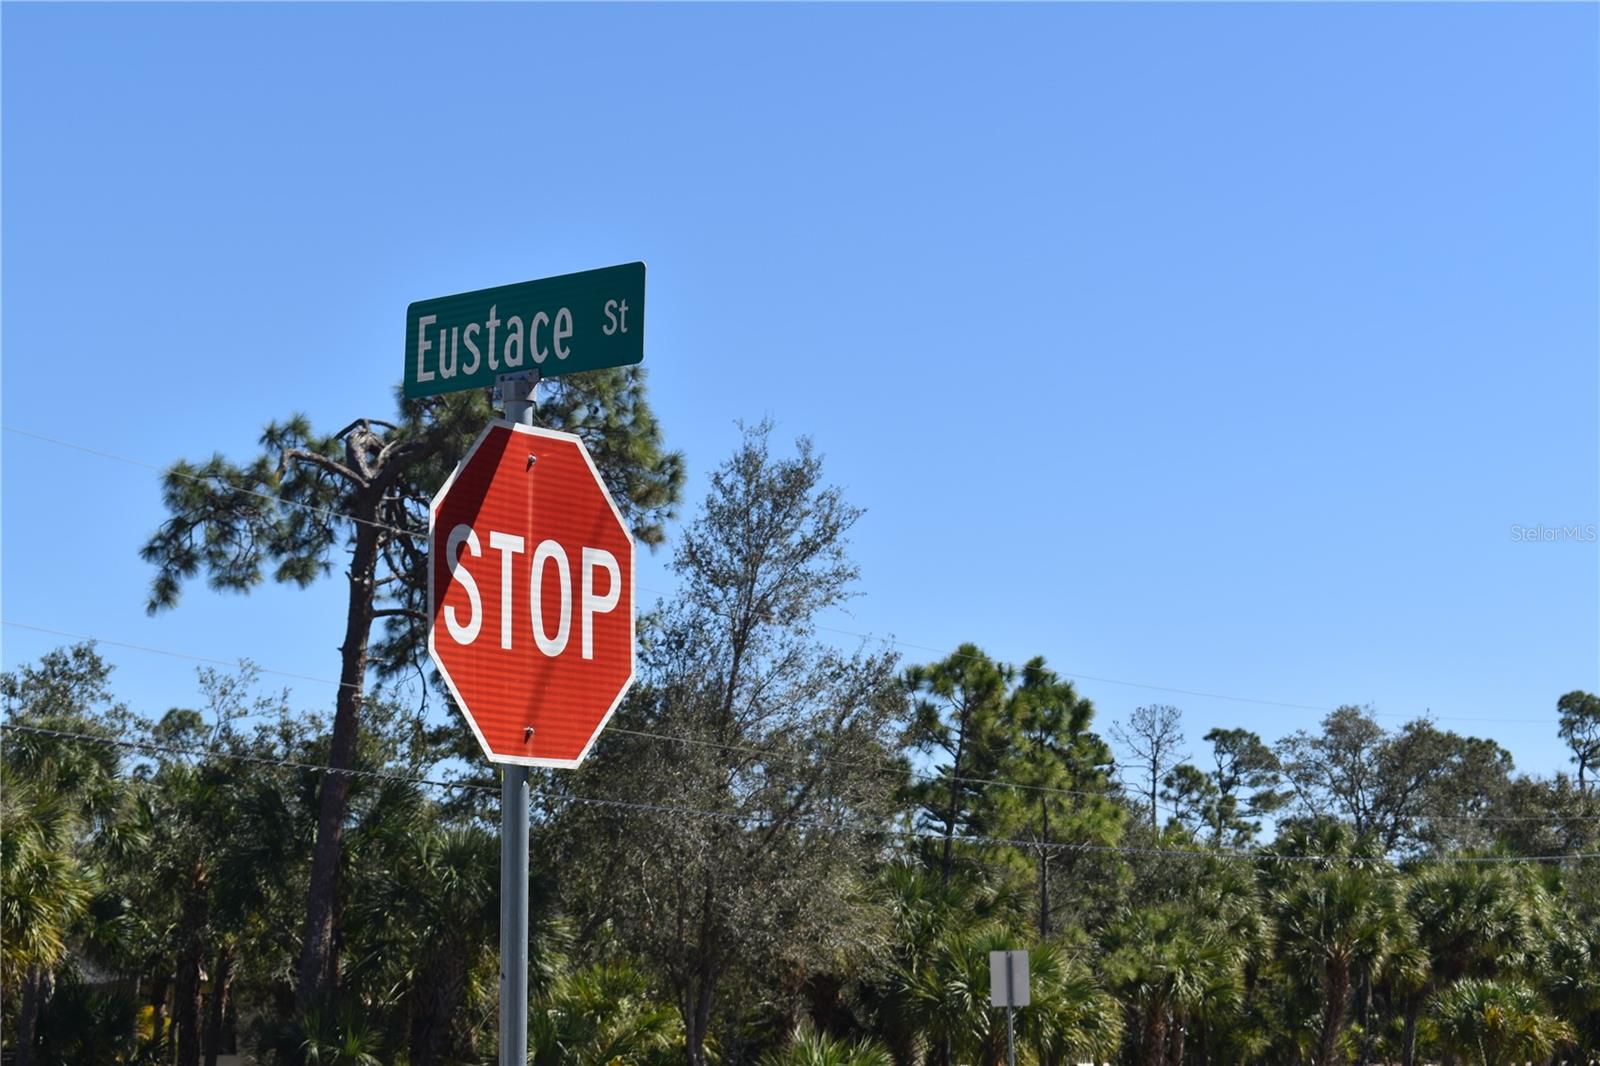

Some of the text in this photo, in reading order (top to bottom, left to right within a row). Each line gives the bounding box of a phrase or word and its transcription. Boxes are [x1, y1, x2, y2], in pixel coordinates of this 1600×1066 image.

[417, 299, 629, 382] Eustace St
[444, 524, 621, 660] STOP
